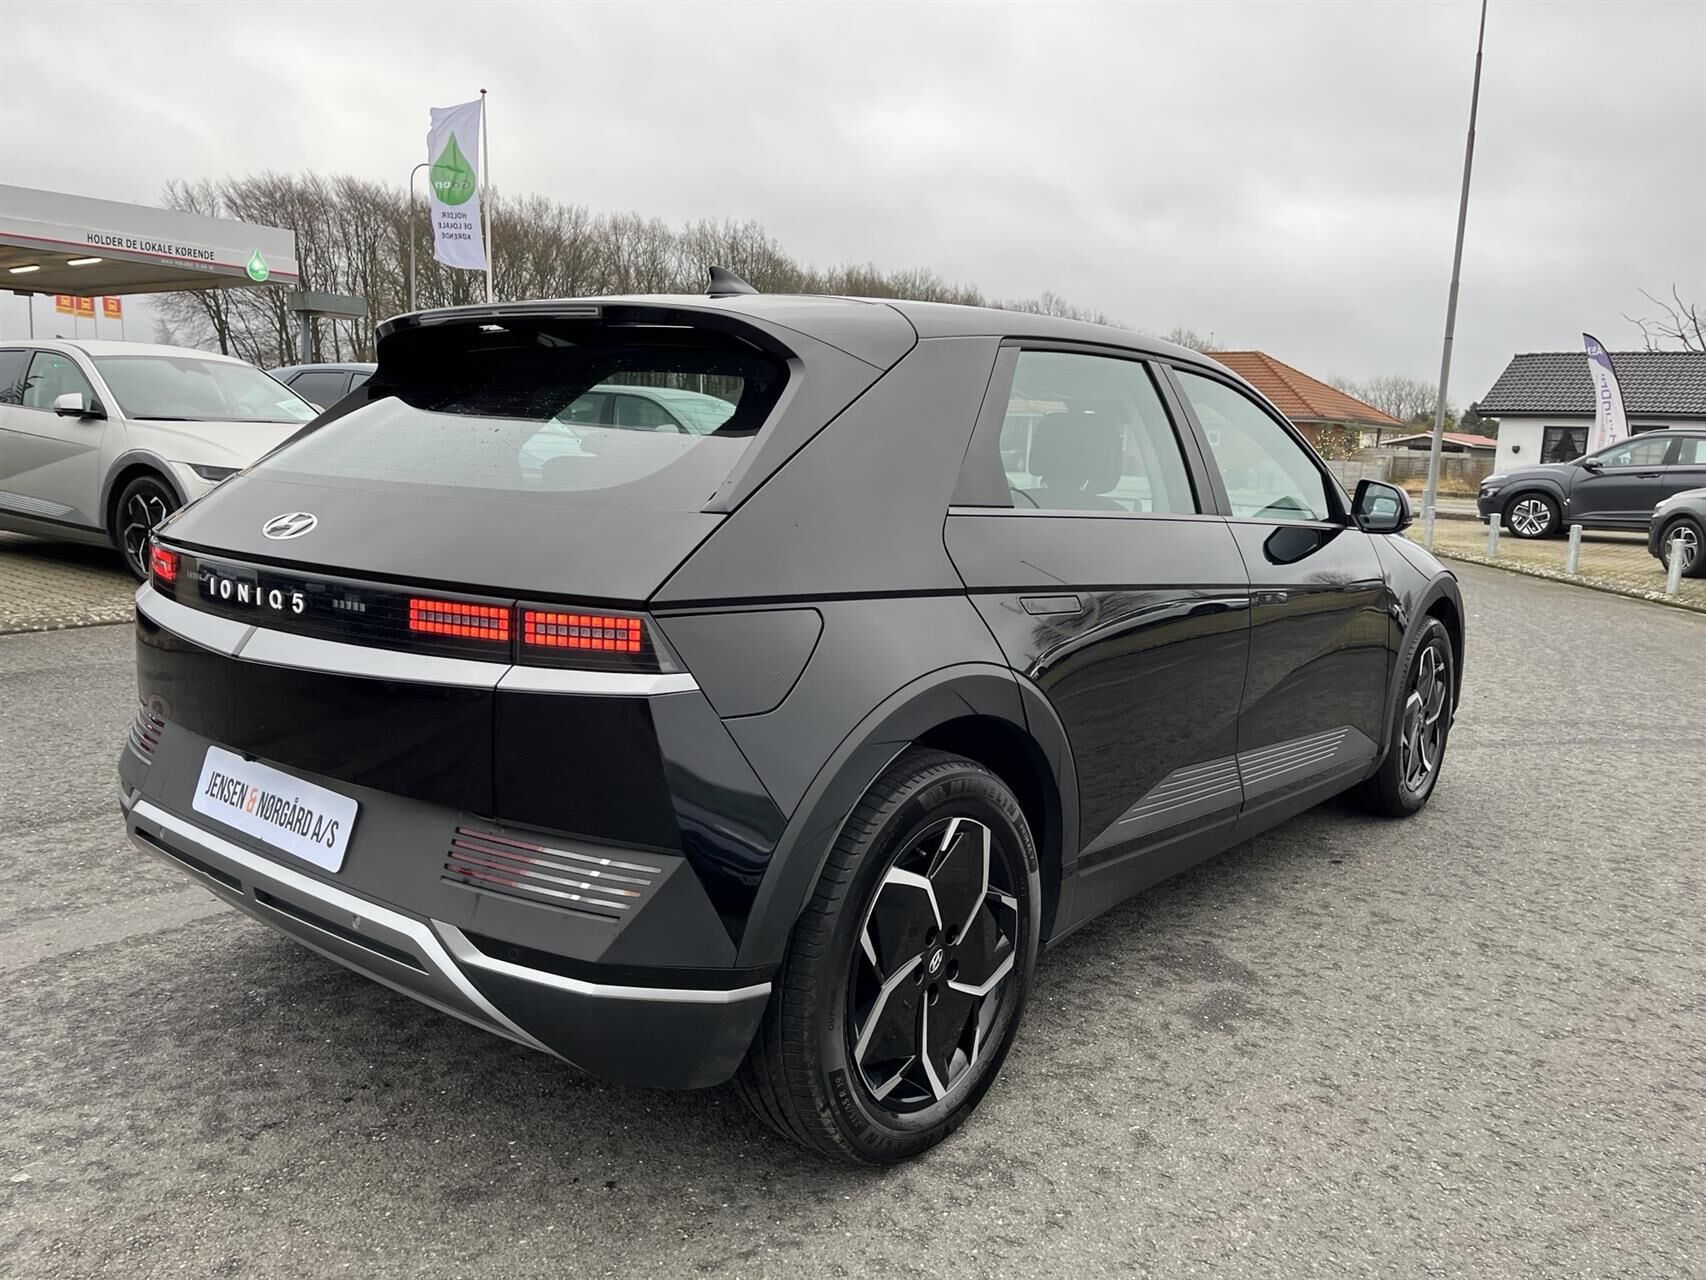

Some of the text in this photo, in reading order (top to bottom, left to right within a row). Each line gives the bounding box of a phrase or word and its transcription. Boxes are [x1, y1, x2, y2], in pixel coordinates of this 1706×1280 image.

[87, 233, 215, 260] HOLDER DE LOKALE KØRENDE
[210, 577, 304, 614] IONIQ 5
[205, 771, 340, 848] JENSEN & NØRGÅRD A/S
